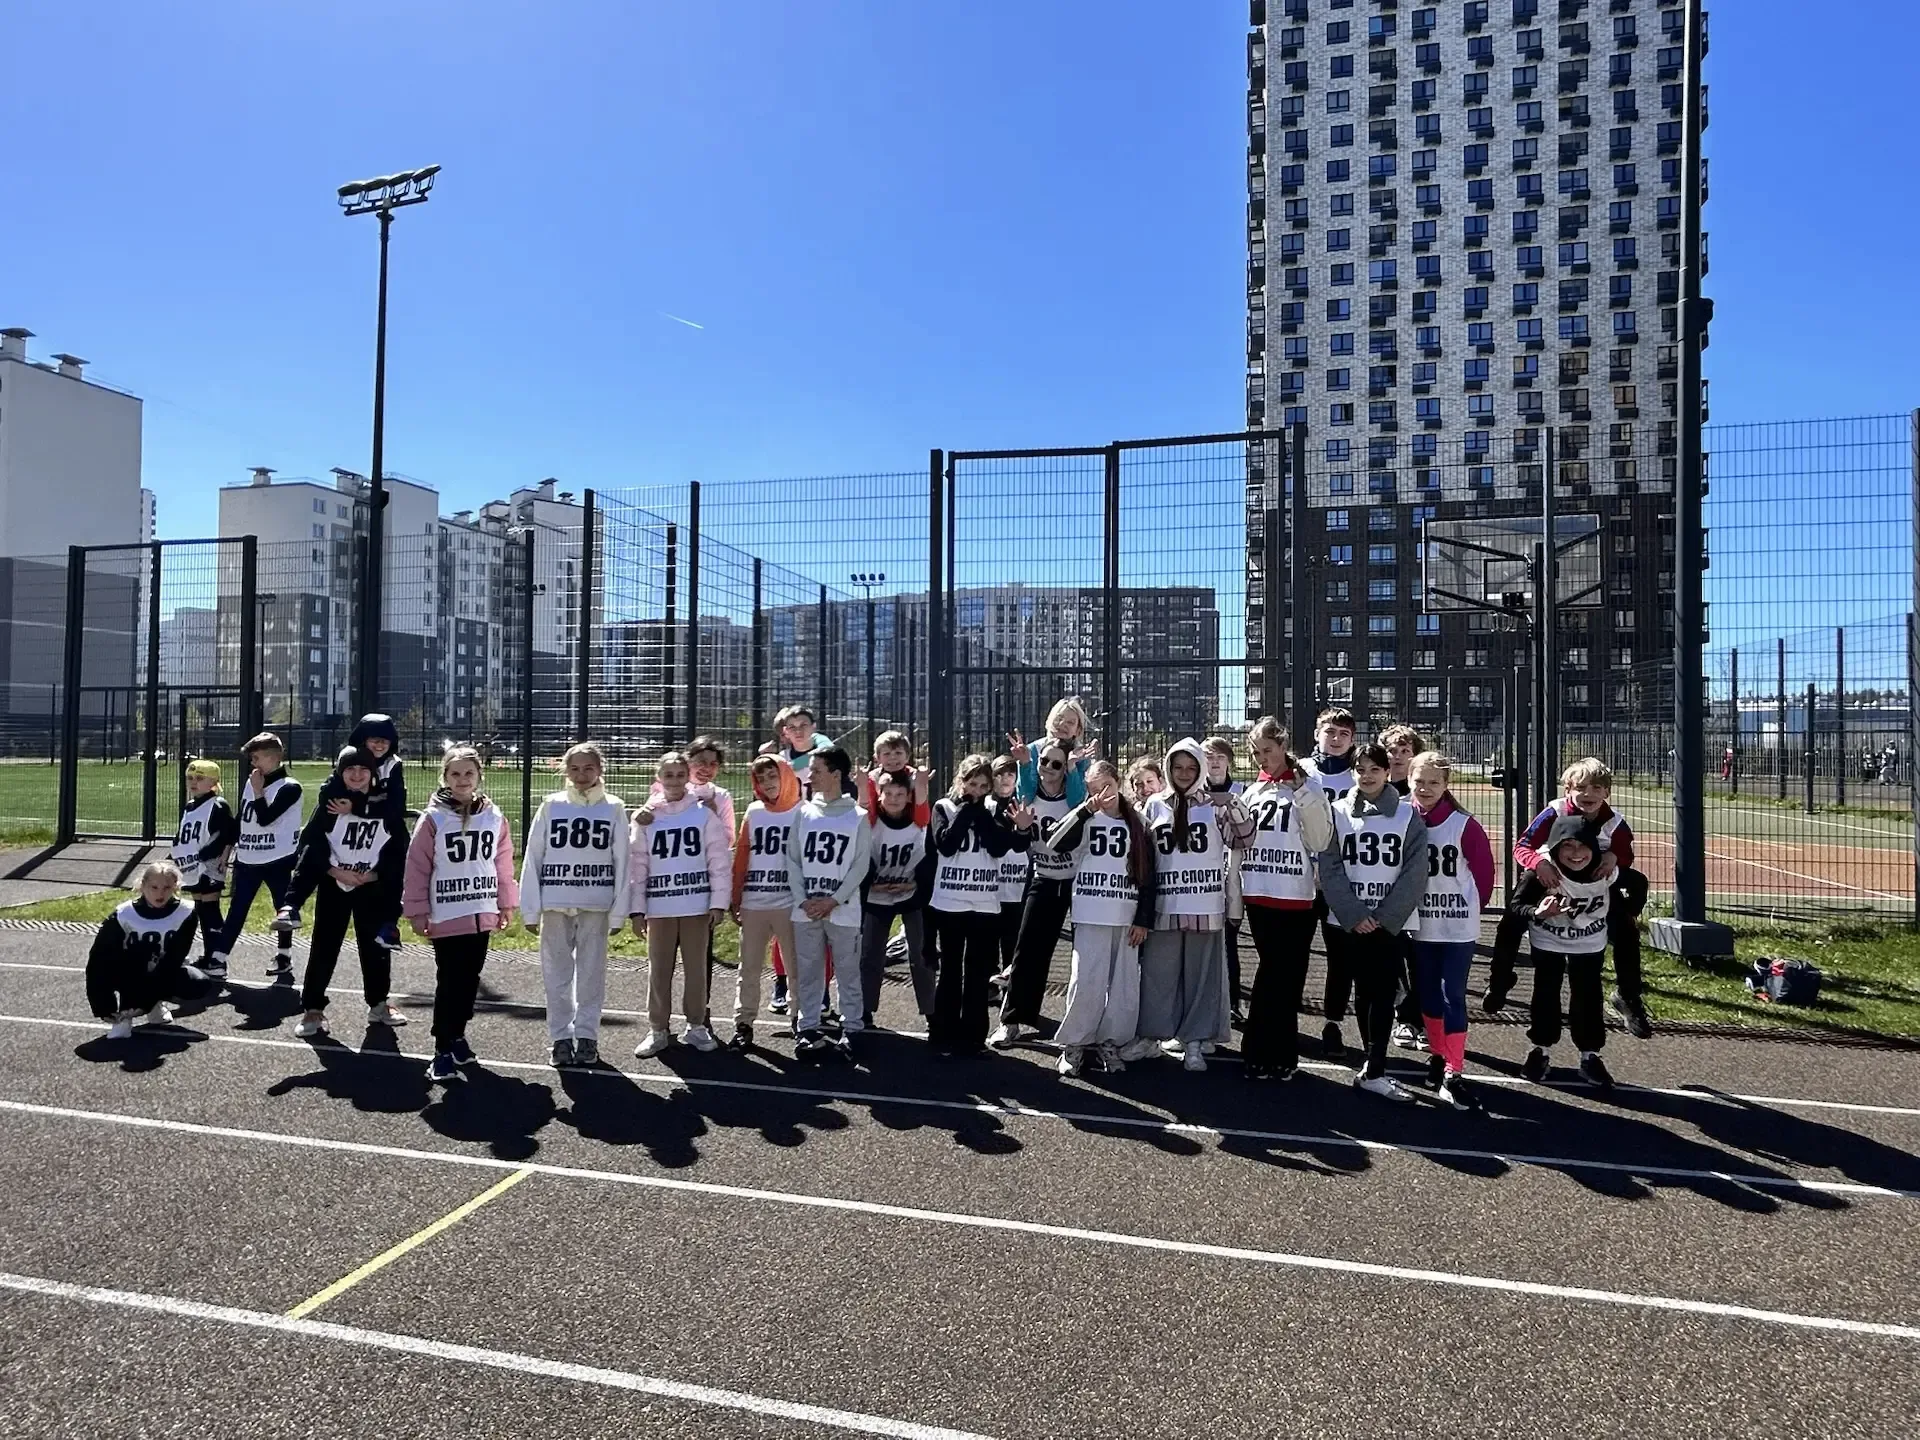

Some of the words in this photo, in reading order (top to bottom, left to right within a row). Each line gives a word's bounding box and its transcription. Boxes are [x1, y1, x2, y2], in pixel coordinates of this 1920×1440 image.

[445, 830, 494, 863] 578
[550, 817, 611, 850] 585
[651, 826, 701, 859] 479
[804, 831, 850, 865] 437
[1154, 822, 1208, 855] 53
[1342, 832, 1401, 867] 433
[941, 866, 970, 881] ЦЕНТР
[1260, 849, 1303, 865] СПОРТА
[436, 877, 470, 896] ЦЕНТР
